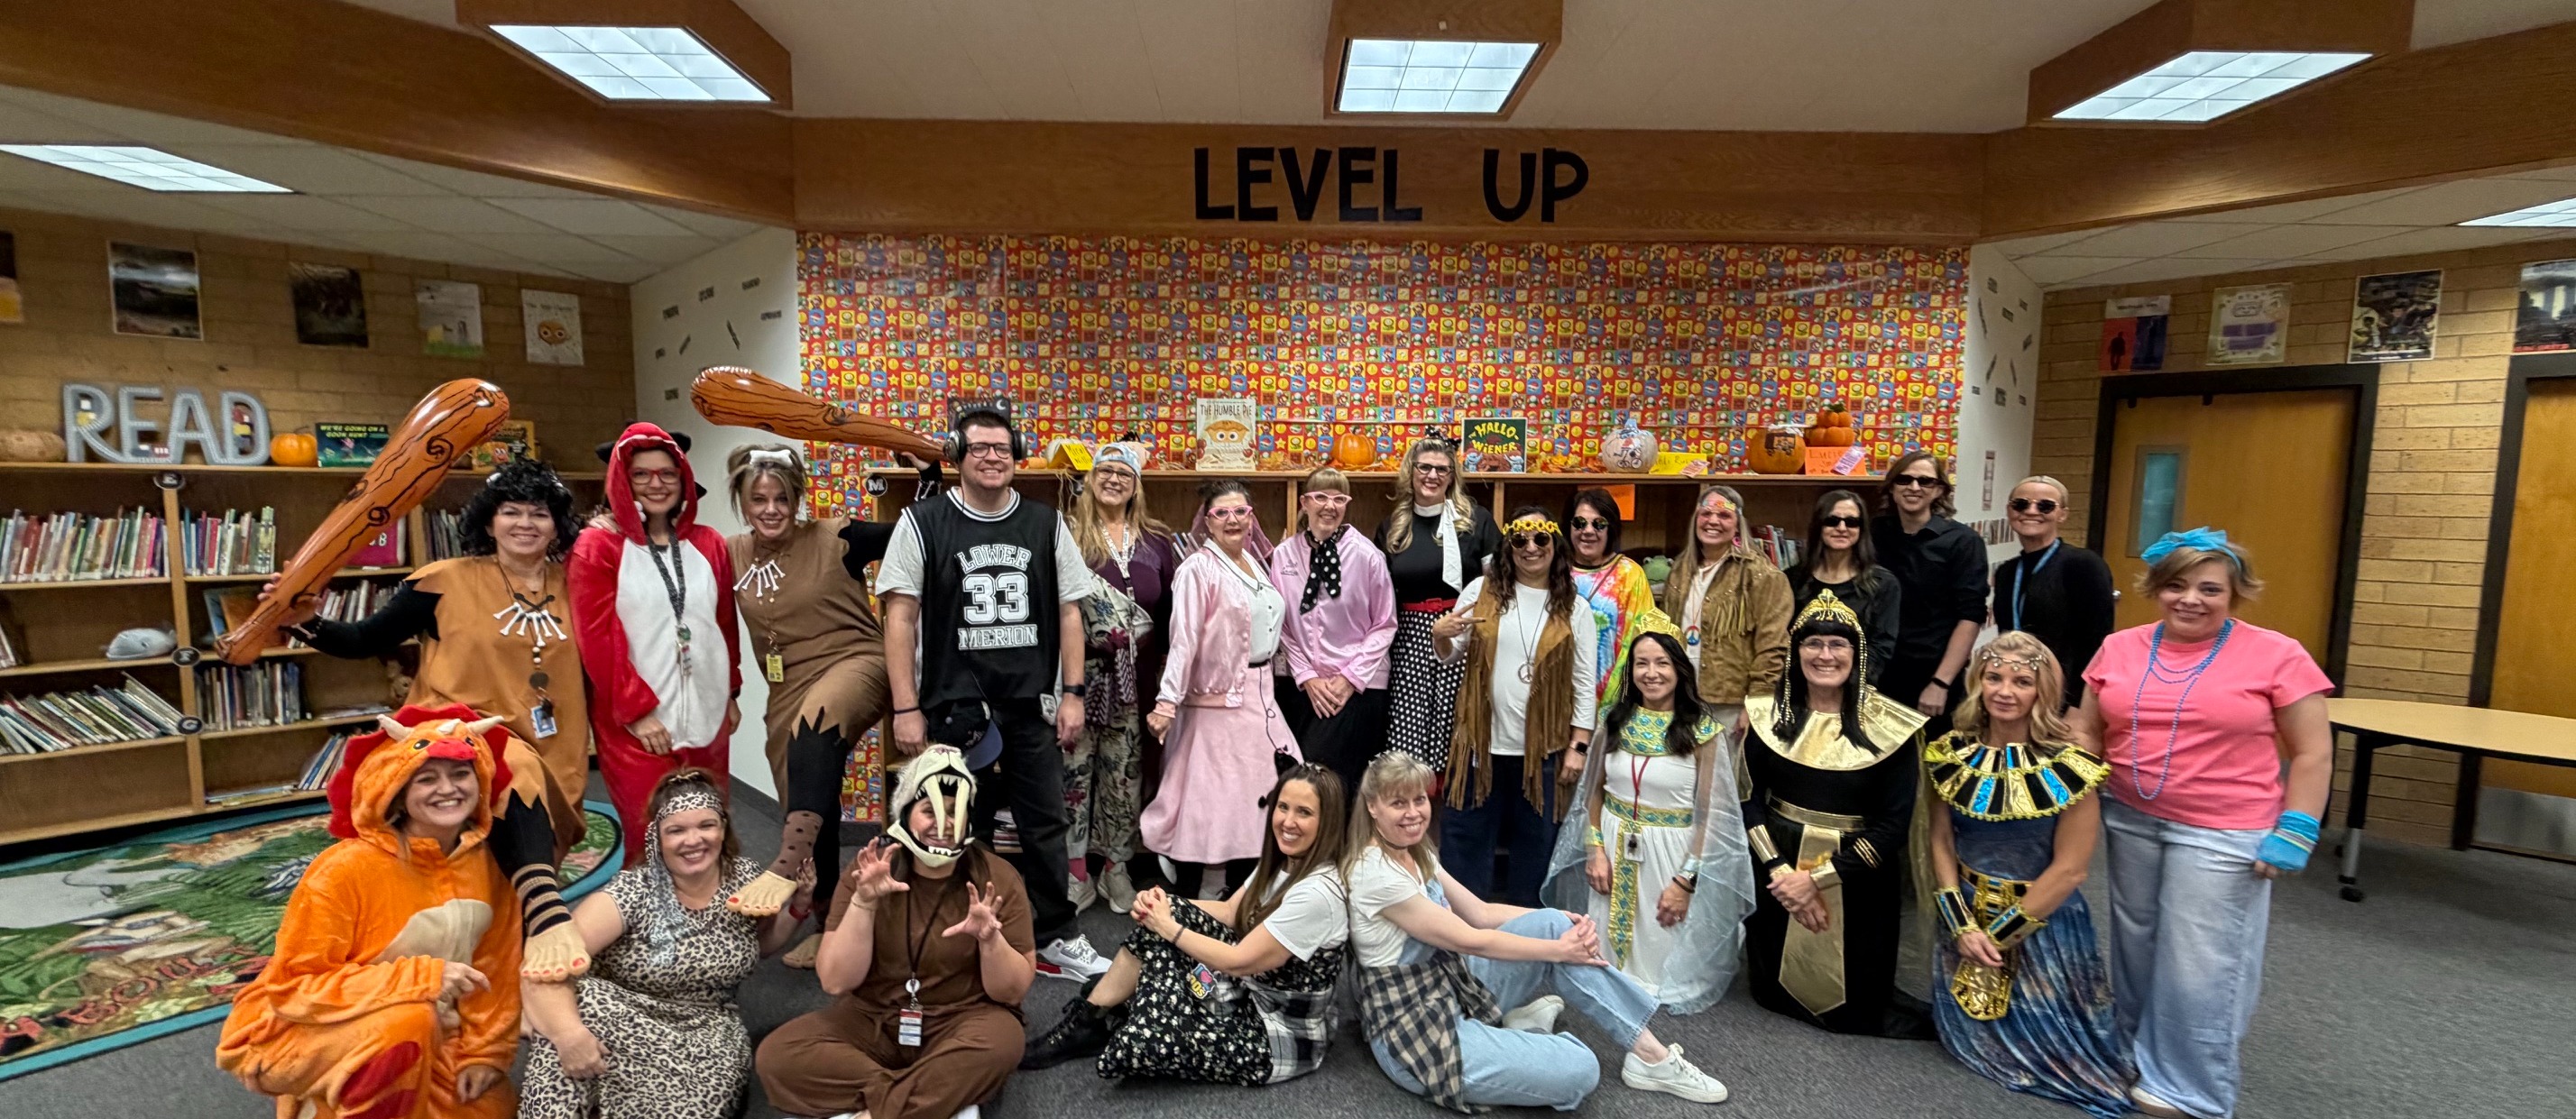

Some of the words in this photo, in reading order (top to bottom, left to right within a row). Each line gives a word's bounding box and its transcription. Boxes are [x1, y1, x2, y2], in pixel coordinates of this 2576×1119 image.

[1194, 147, 1422, 222] LEVEL
[1483, 148, 1588, 222] UP
[63, 383, 270, 465] READ
[1201, 404, 1212, 416] THE
[1214, 404, 1240, 416] HUMBLE
[1242, 404, 1252, 416] PIE
[868, 478, 885, 491] M
[956, 544, 1033, 574] LOWER
[962, 572, 1030, 625] 33
[957, 623, 1039, 651] MERION
[181, 720, 198, 730] G
